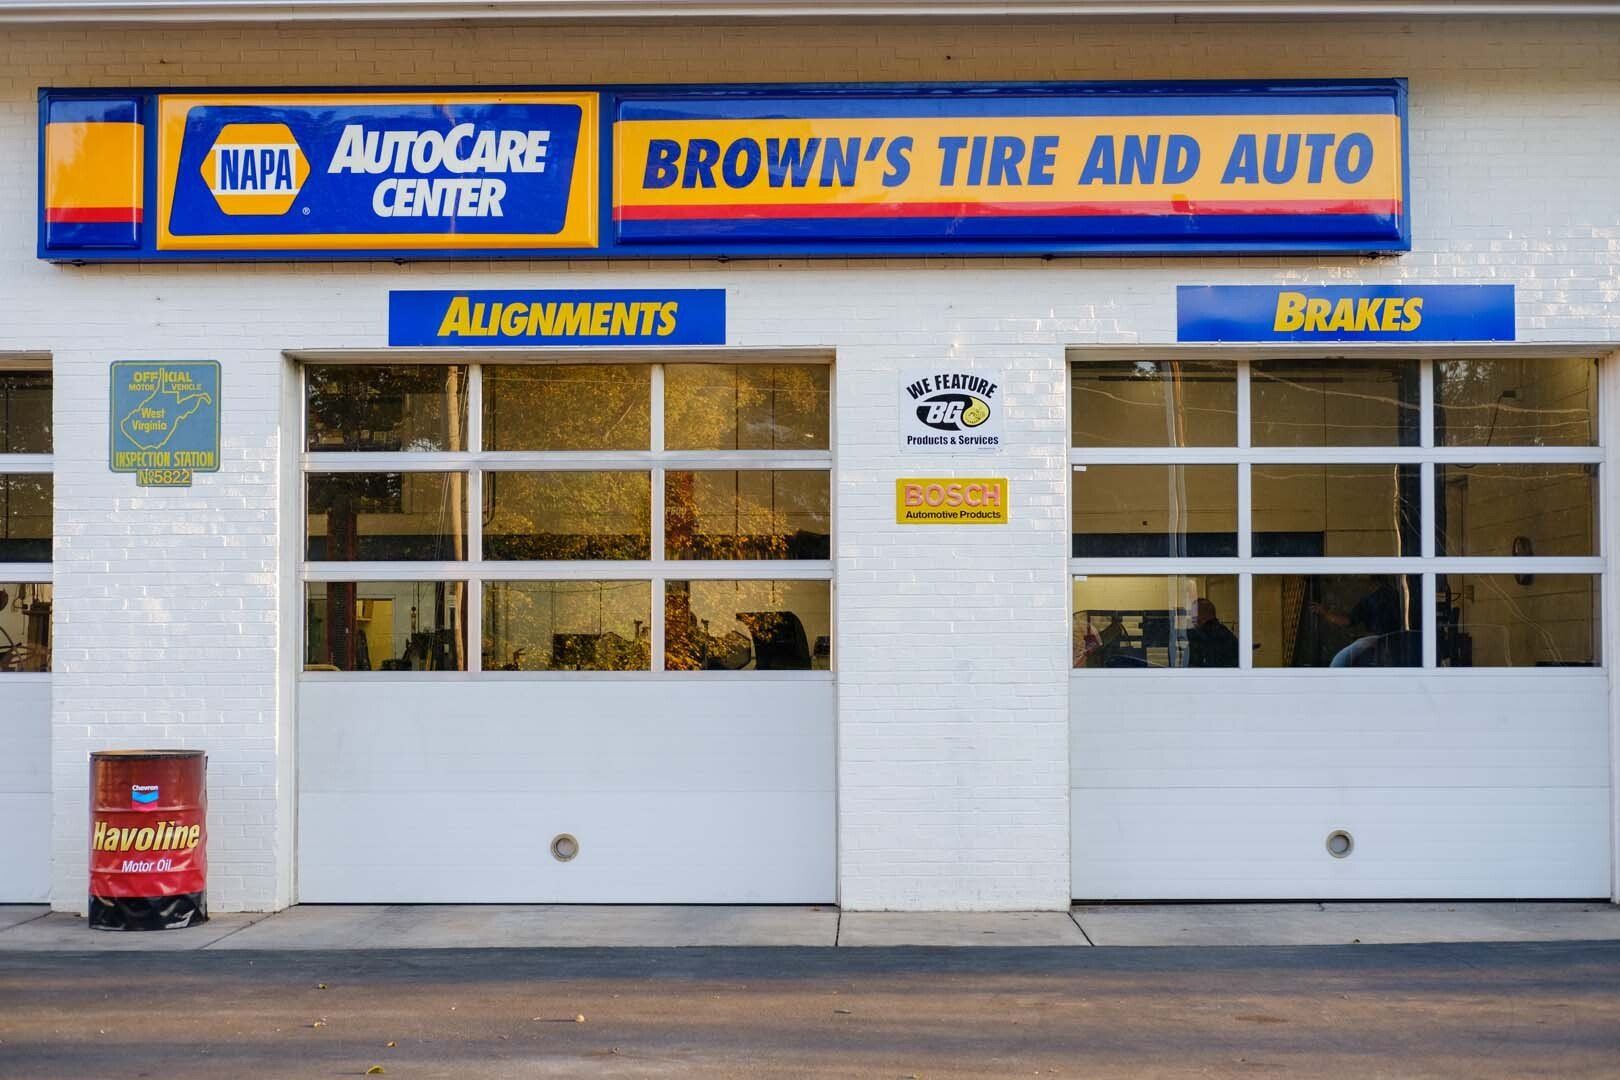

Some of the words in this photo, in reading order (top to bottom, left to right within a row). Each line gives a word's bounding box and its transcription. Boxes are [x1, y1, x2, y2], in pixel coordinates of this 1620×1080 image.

[327, 123, 551, 174] AUTOCARE
[221, 148, 293, 190] NAPA
[642, 136, 914, 189] BROWN'S
[938, 136, 1060, 187] TIRE
[1078, 134, 1201, 186] AND
[1220, 132, 1374, 184] AUTO
[372, 178, 507, 217] CENTER
[436, 296, 678, 337] ALIGNMENTS
[1273, 291, 1423, 332] BRAKES
[128, 383, 155, 391] MOTOR
[171, 383, 202, 391] VEHICLE
[906, 378, 932, 400] WE
[934, 374, 998, 399] FEATURE
[141, 407, 165, 418] West
[926, 401, 966, 424] BG
[132, 419, 168, 432] Virginia
[907, 435, 949, 445] Products
[950, 436, 957, 445] &
[958, 435, 999, 445] Services
[116, 451, 171, 467] INSPECTION
[173, 451, 214, 467] STATION
[904, 484, 1001, 507] BOSCH
[906, 510, 958, 519] Automotive
[959, 510, 1001, 519] Products
[93, 821, 200, 852] Havoline
[121, 860, 155, 872] Motor
[156, 859, 172, 872] Oil
